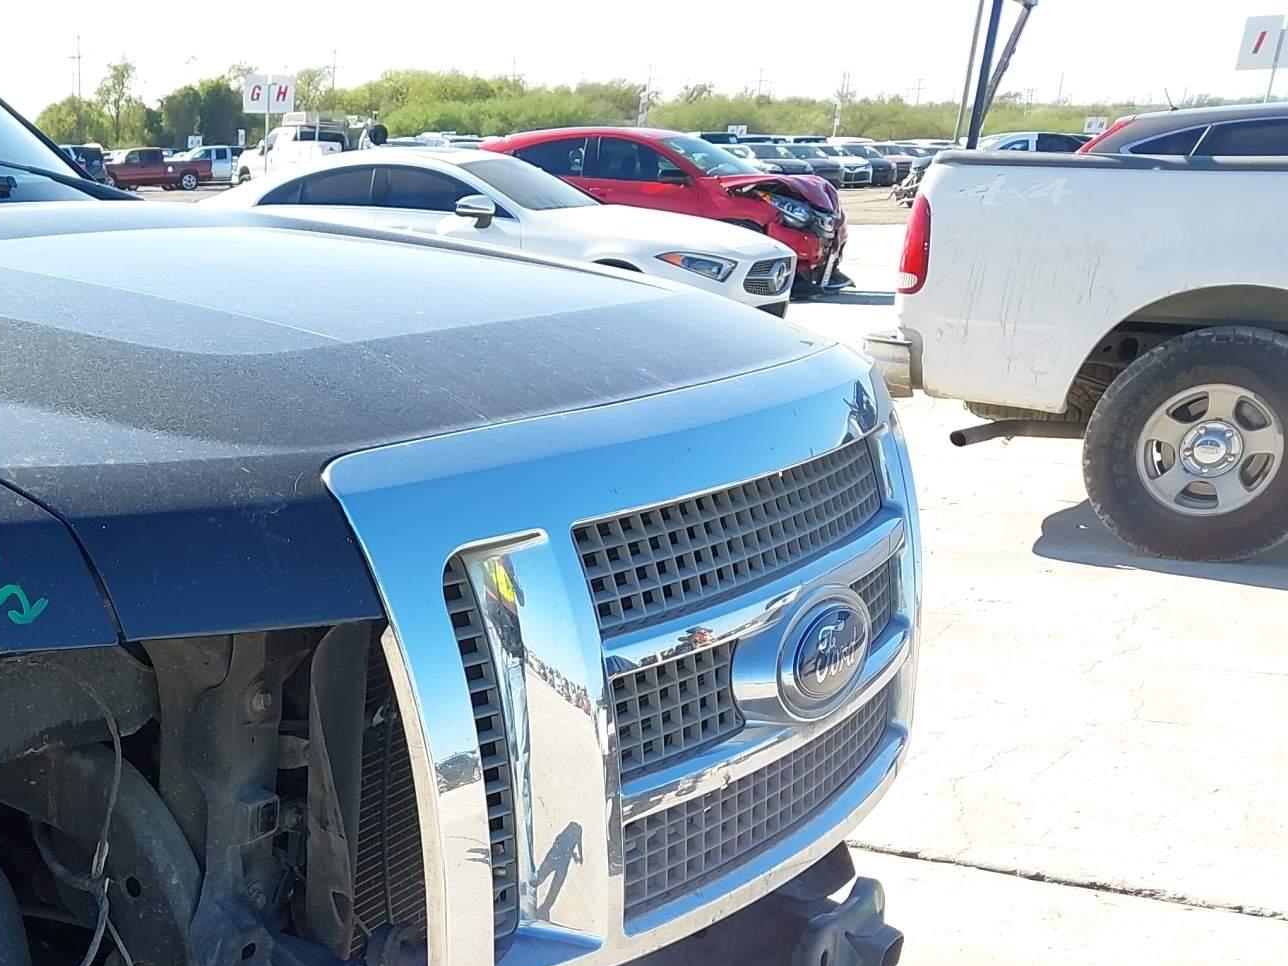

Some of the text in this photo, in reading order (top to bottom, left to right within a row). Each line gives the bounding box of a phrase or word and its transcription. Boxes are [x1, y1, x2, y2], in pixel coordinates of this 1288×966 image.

[250, 84, 289, 102] G H
[815, 619, 858, 685] Ford
